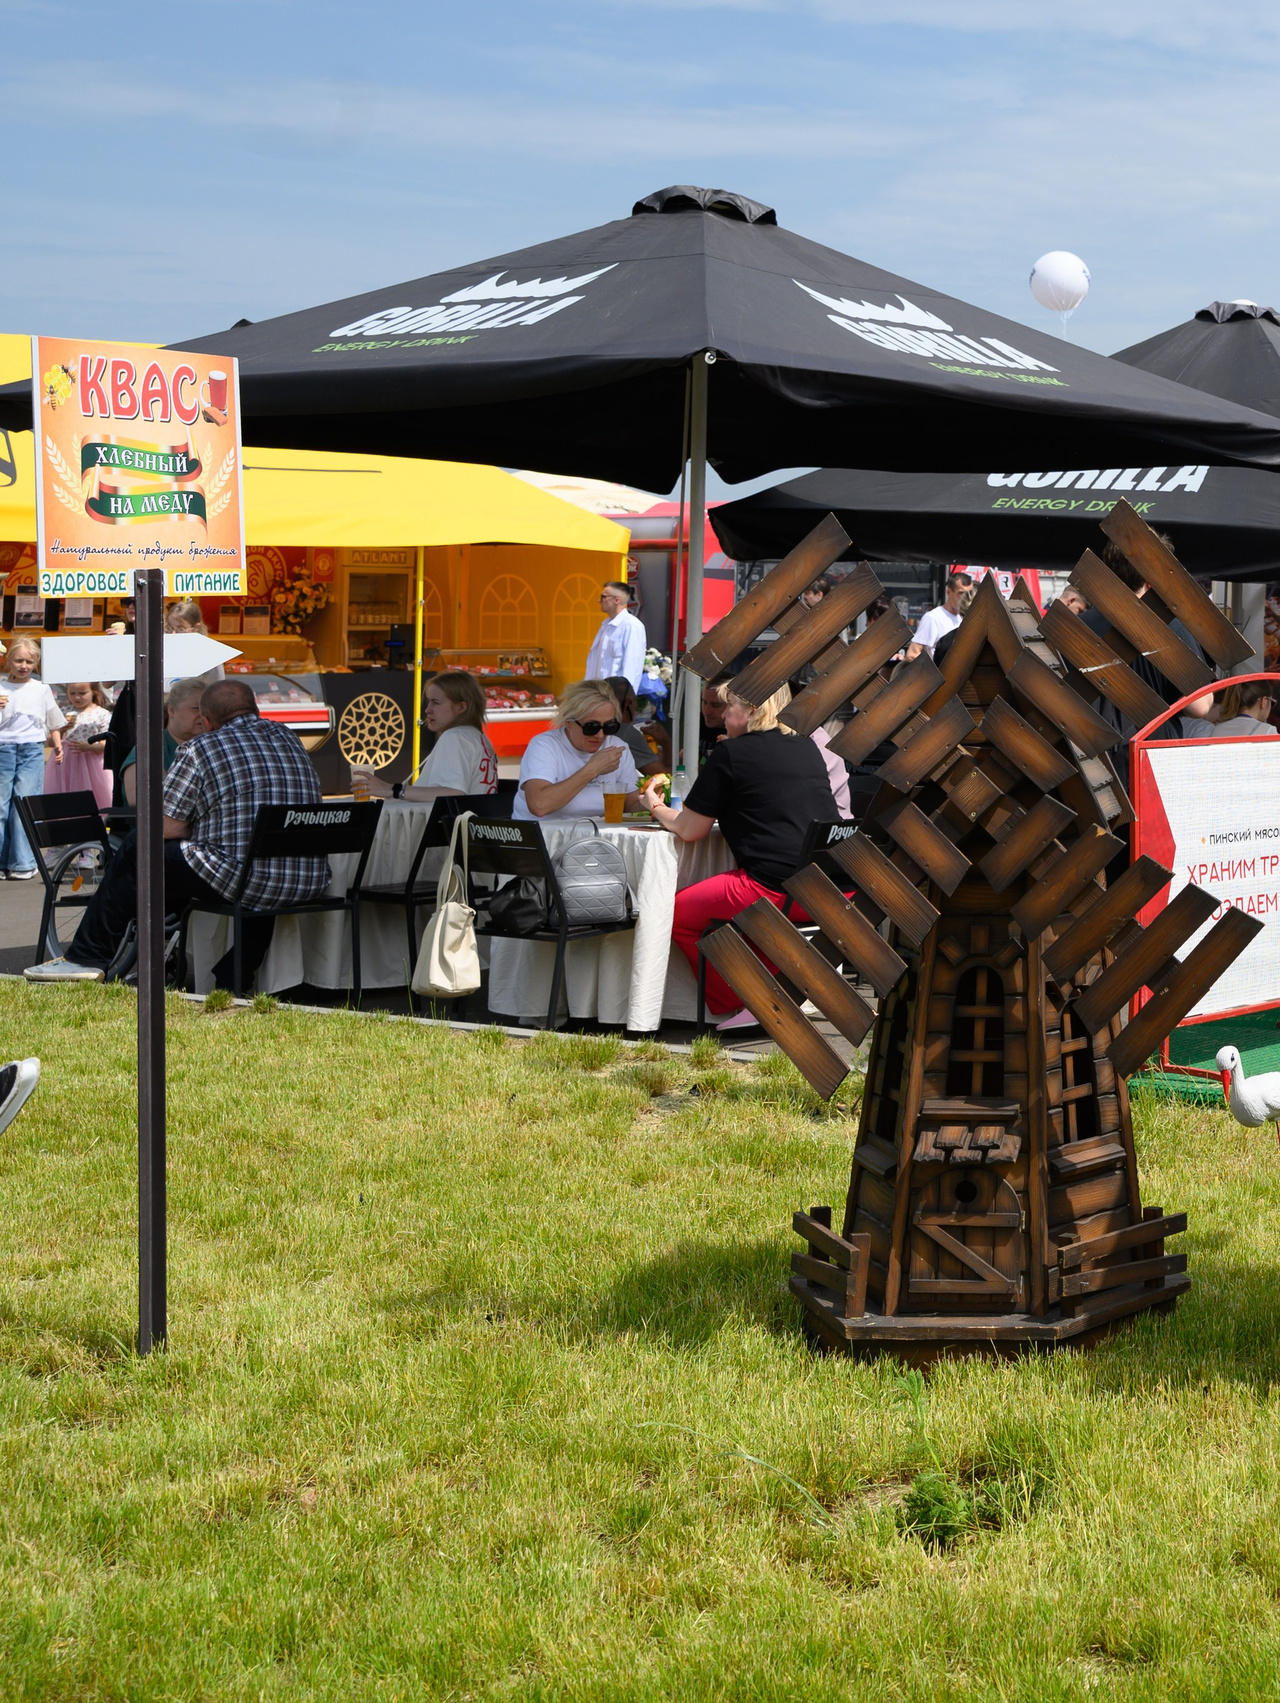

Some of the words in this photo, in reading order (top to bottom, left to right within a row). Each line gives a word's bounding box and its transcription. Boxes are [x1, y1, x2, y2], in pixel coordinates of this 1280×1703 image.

[329, 295, 587, 337] GORILLA
[826, 314, 1062, 373] GORILLA
[78, 354, 200, 425] КВАС
[95, 446, 188, 473] ХЛЕБНЫЙ
[110, 497, 135, 514] НА
[141, 493, 194, 515] МЕДУ
[991, 498, 1084, 511] ENERGY
[51, 539, 133, 561] Натуральный
[137, 541, 185, 561] продукт
[188, 541, 237, 561] брожения
[42, 572, 127, 595] ЗДОРОВОЕ
[175, 573, 240, 592] ПИТАНИЕ
[283, 810, 351, 828] Рэчыцкае
[469, 821, 523, 843] Рэчыцкае
[1209, 828, 1252, 845] ПИНСКИЙ
[1187, 858, 1256, 885] ХРАНИМ
